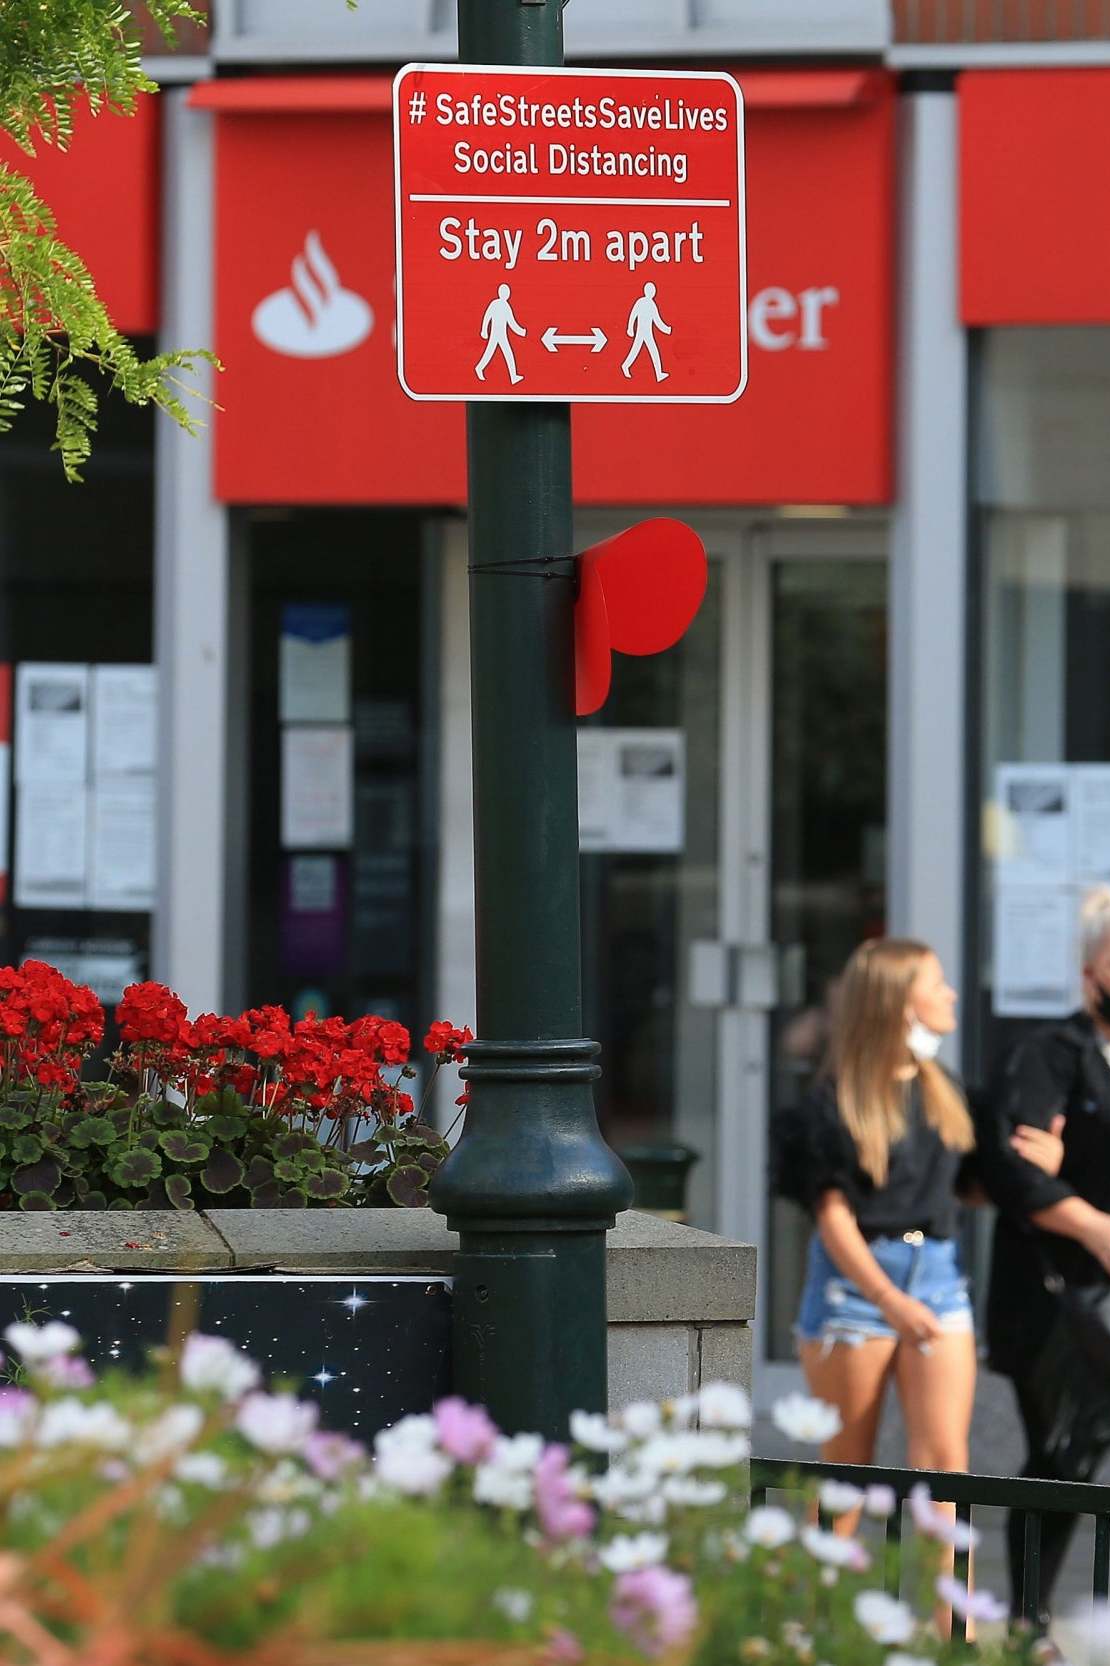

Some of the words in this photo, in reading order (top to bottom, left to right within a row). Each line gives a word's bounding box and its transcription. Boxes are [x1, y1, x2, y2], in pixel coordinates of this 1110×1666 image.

[436, 93, 728, 131] SafeStreetsSaveLives
[454, 141, 539, 174] Social
[549, 143, 688, 183] Distancing
[439, 217, 523, 270] Stay
[536, 218, 591, 261] 2m
[605, 221, 704, 271] apart
